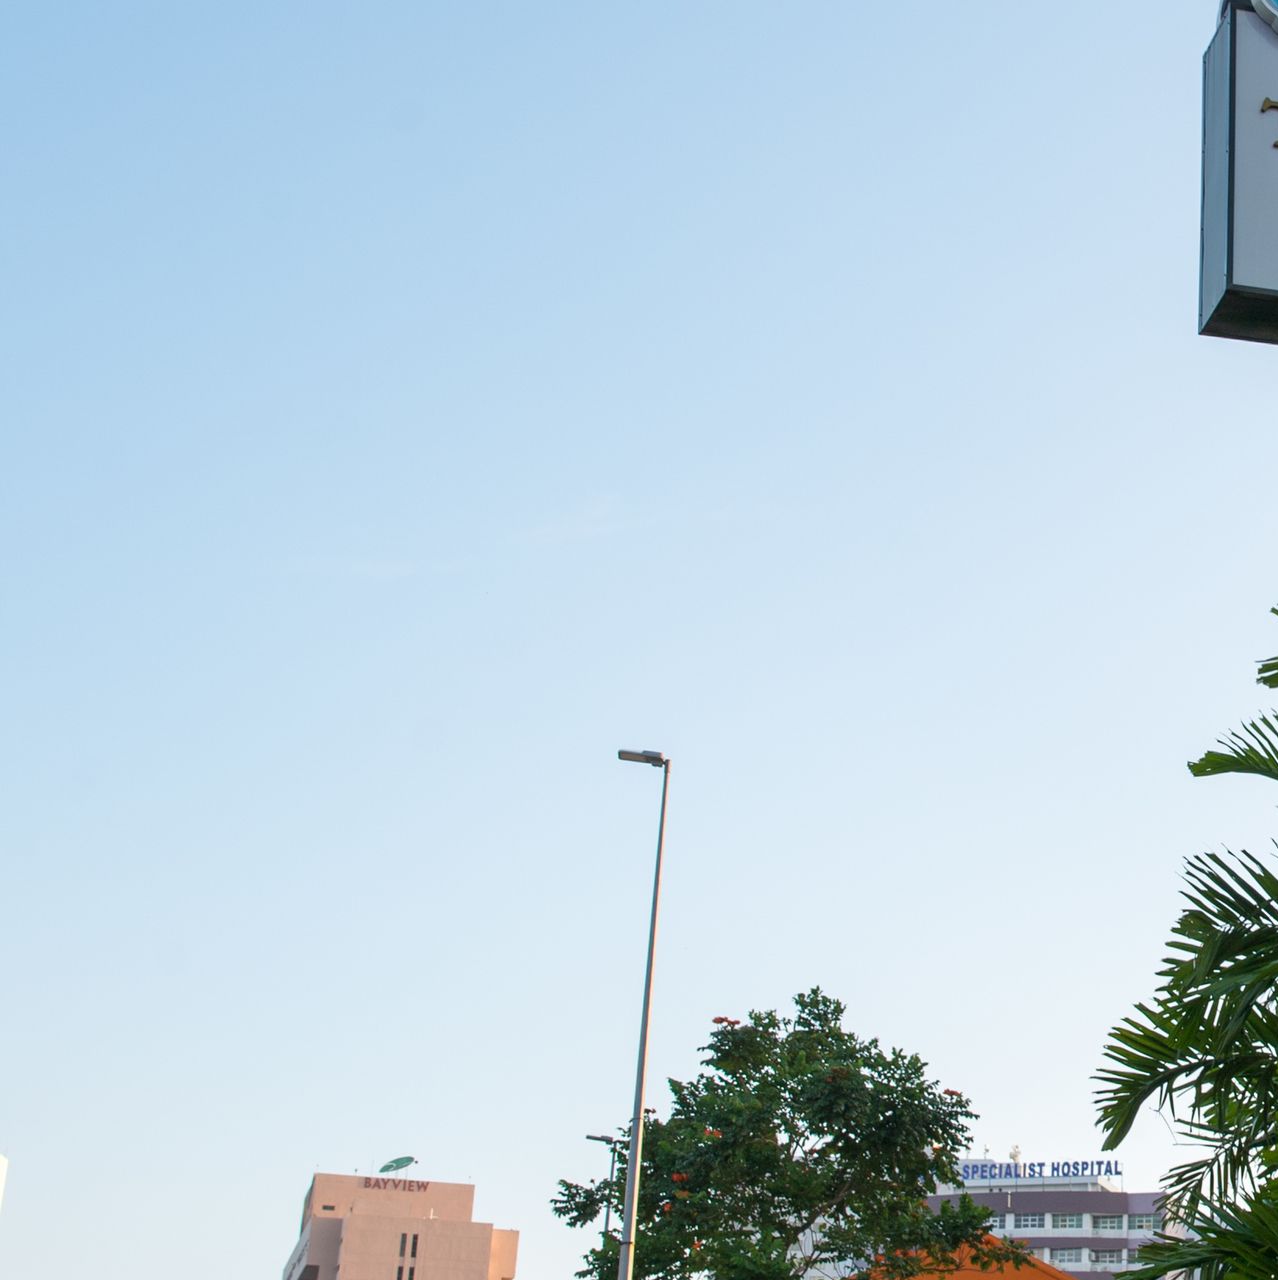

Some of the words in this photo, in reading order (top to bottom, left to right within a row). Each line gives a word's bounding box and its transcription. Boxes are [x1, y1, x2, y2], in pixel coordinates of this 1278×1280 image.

[962, 1162, 1045, 1180] SPECIALIST
[1051, 1160, 1122, 1177] HOSPITAL
[364, 1177, 430, 1193] BAYVIEW
